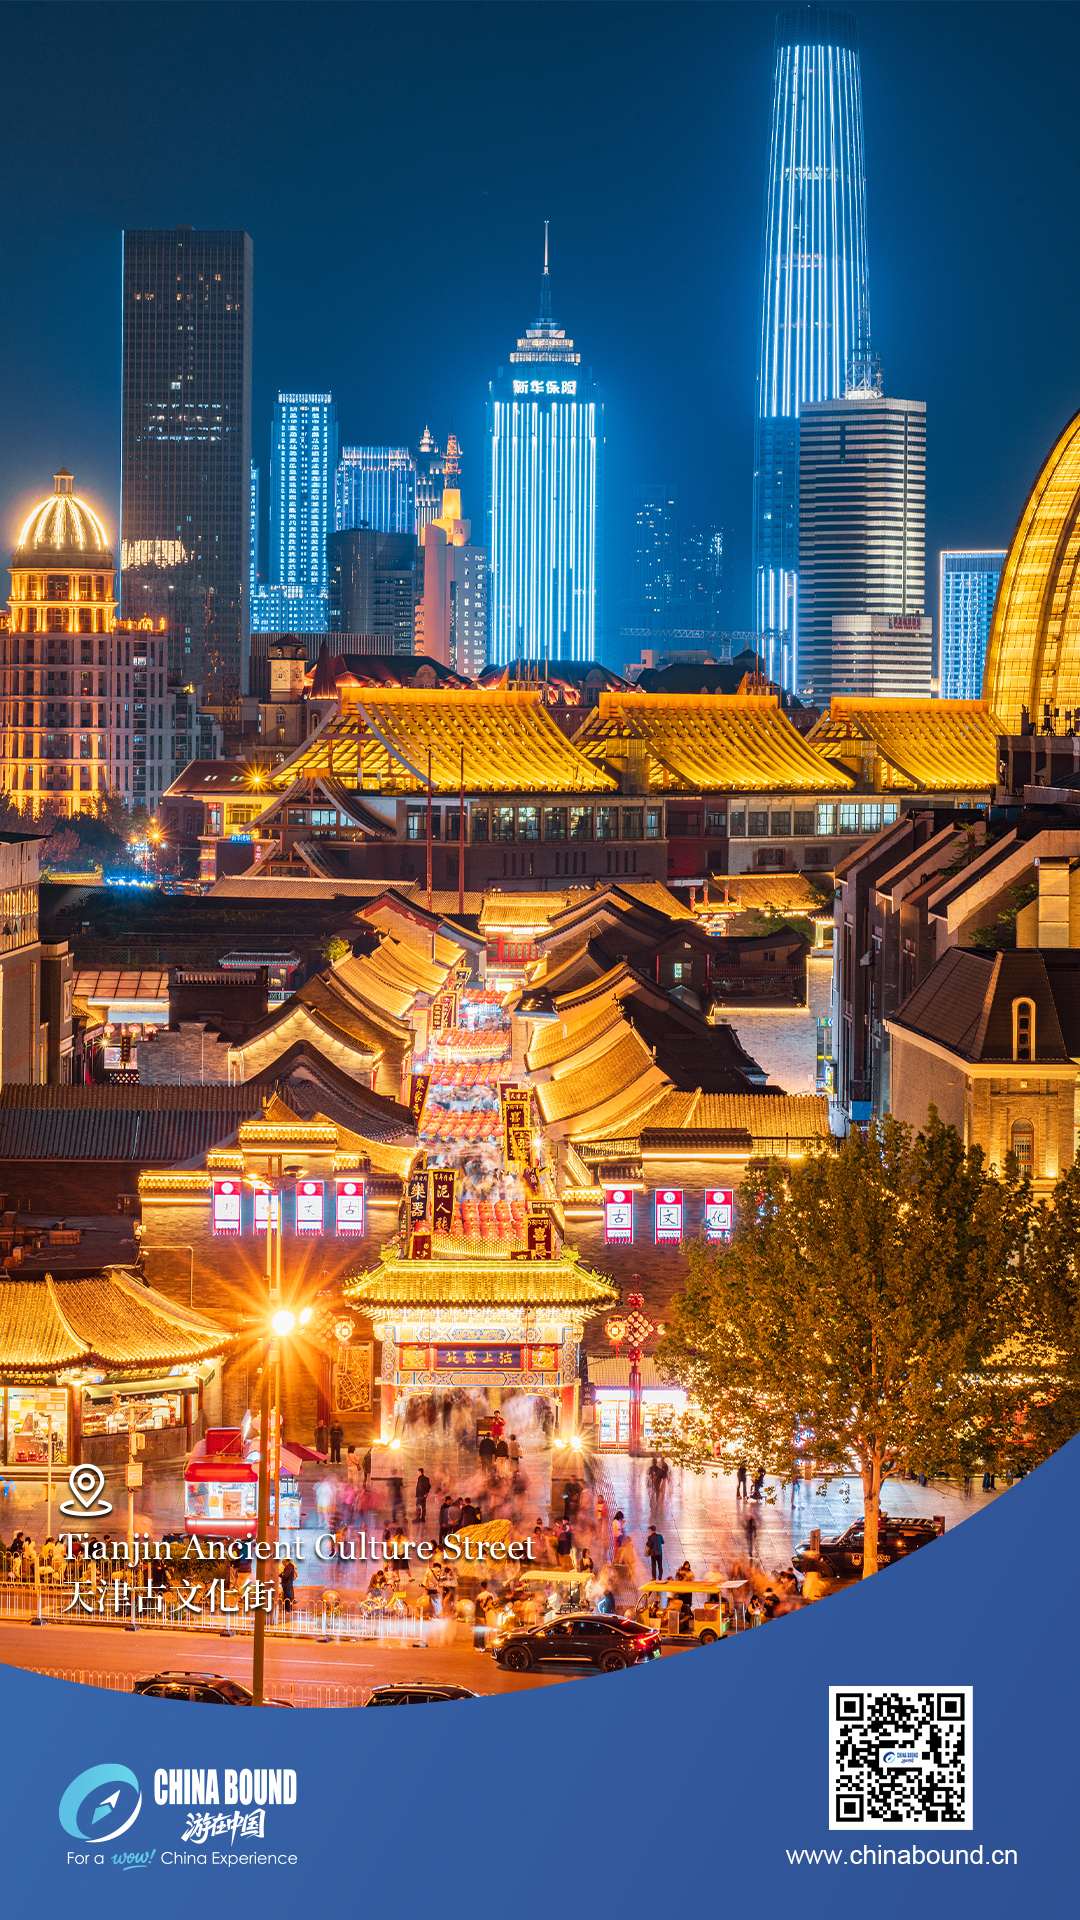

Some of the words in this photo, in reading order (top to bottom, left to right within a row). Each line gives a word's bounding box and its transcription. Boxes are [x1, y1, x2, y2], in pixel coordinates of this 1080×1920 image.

[513, 380, 577, 394] 新华保险
[342, 1201, 358, 1215] 古
[611, 1209, 627, 1223] 古
[662, 1209, 677, 1224] 文
[711, 1210, 727, 1223] 化
[876, 1555, 891, 1563] 公安
